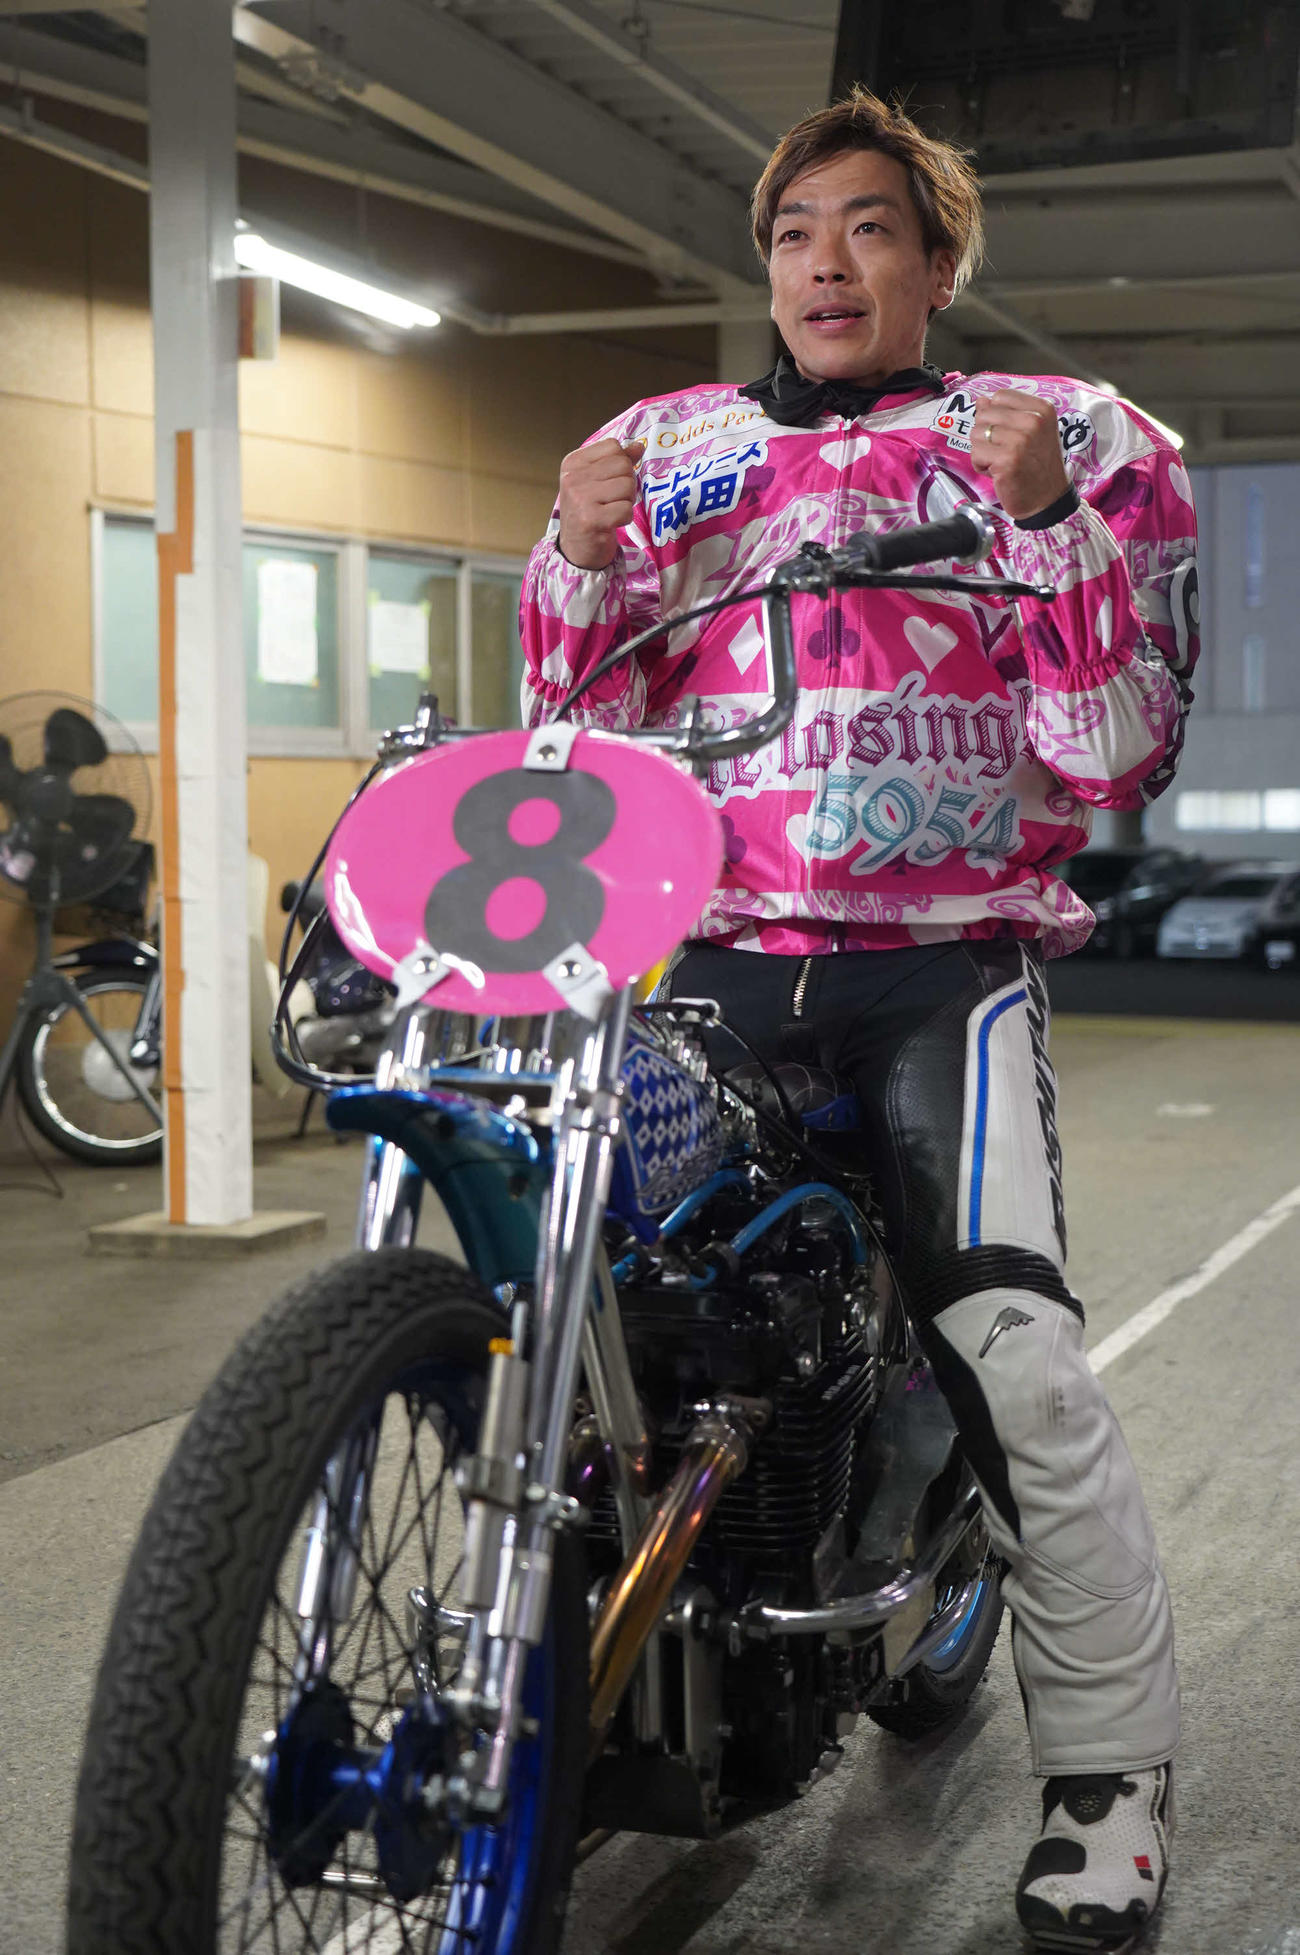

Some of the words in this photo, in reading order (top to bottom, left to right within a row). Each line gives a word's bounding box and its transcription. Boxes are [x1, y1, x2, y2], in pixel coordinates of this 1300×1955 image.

[657, 420, 714, 448] Odds
[950, 437, 973, 450] Mote
[655, 471, 738, 538] 成田
[806, 771, 1017, 869] 5954
[424, 767, 617, 974] 8
